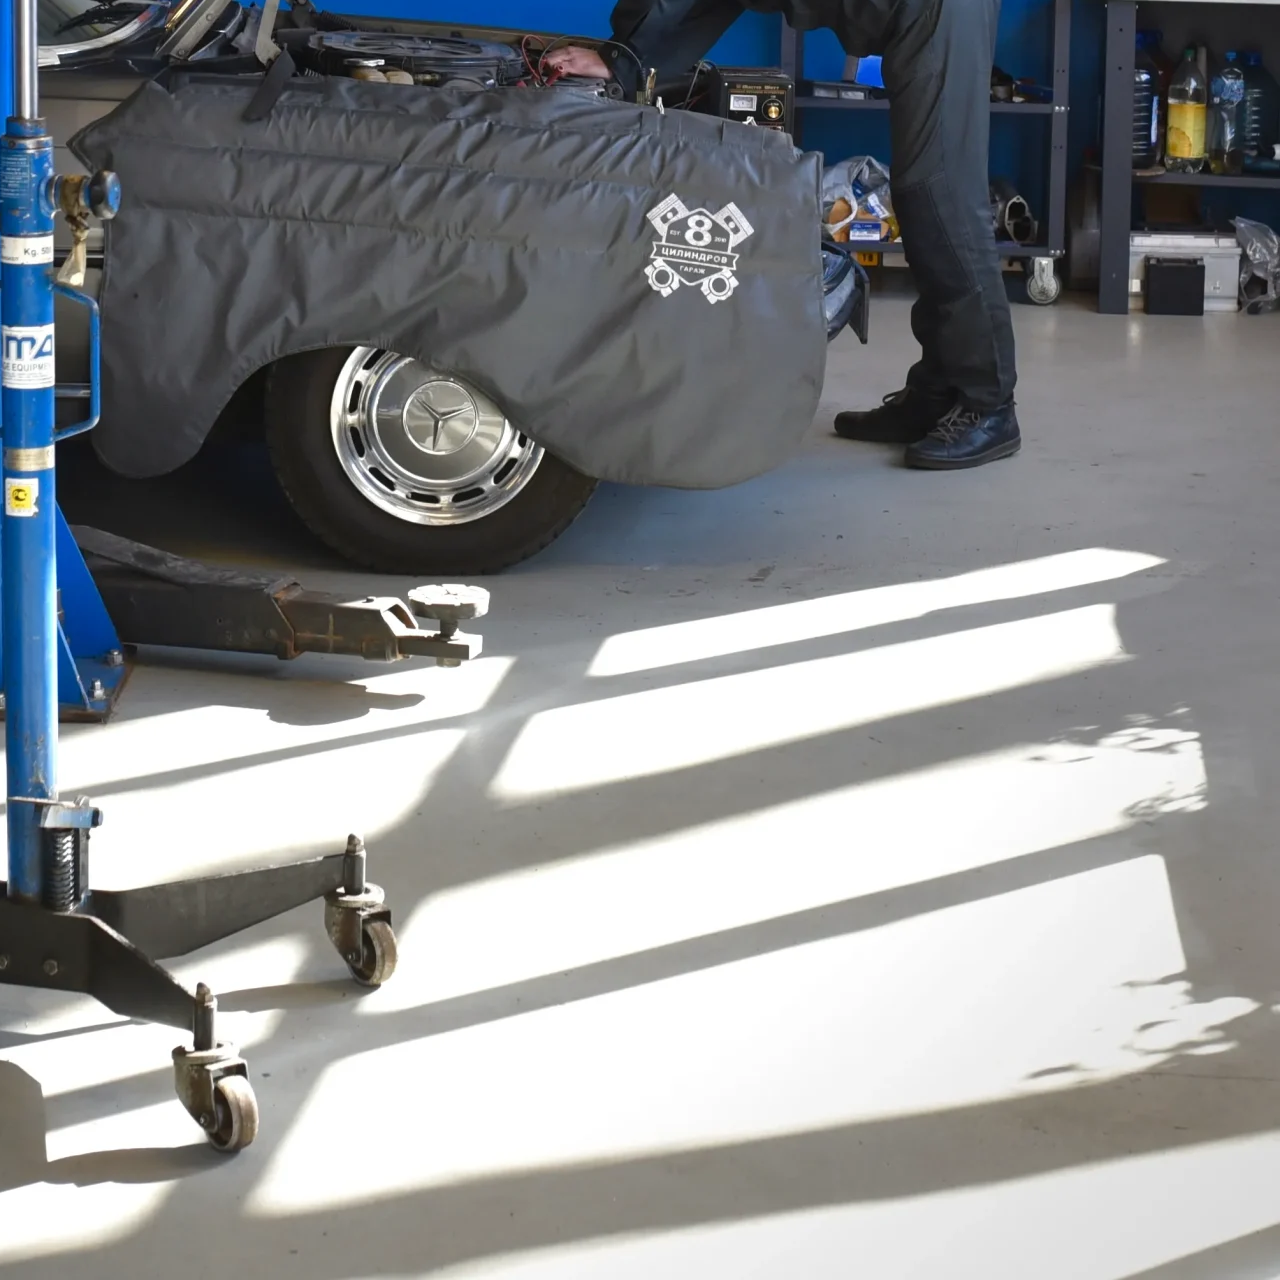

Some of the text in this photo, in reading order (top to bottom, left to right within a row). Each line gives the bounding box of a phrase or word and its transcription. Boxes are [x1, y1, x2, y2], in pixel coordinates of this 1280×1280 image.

[684, 214, 713, 247] 8
[661, 247, 728, 264] ЦИЛИНДРОВ
[679, 265, 706, 275] ГАРАЖ
